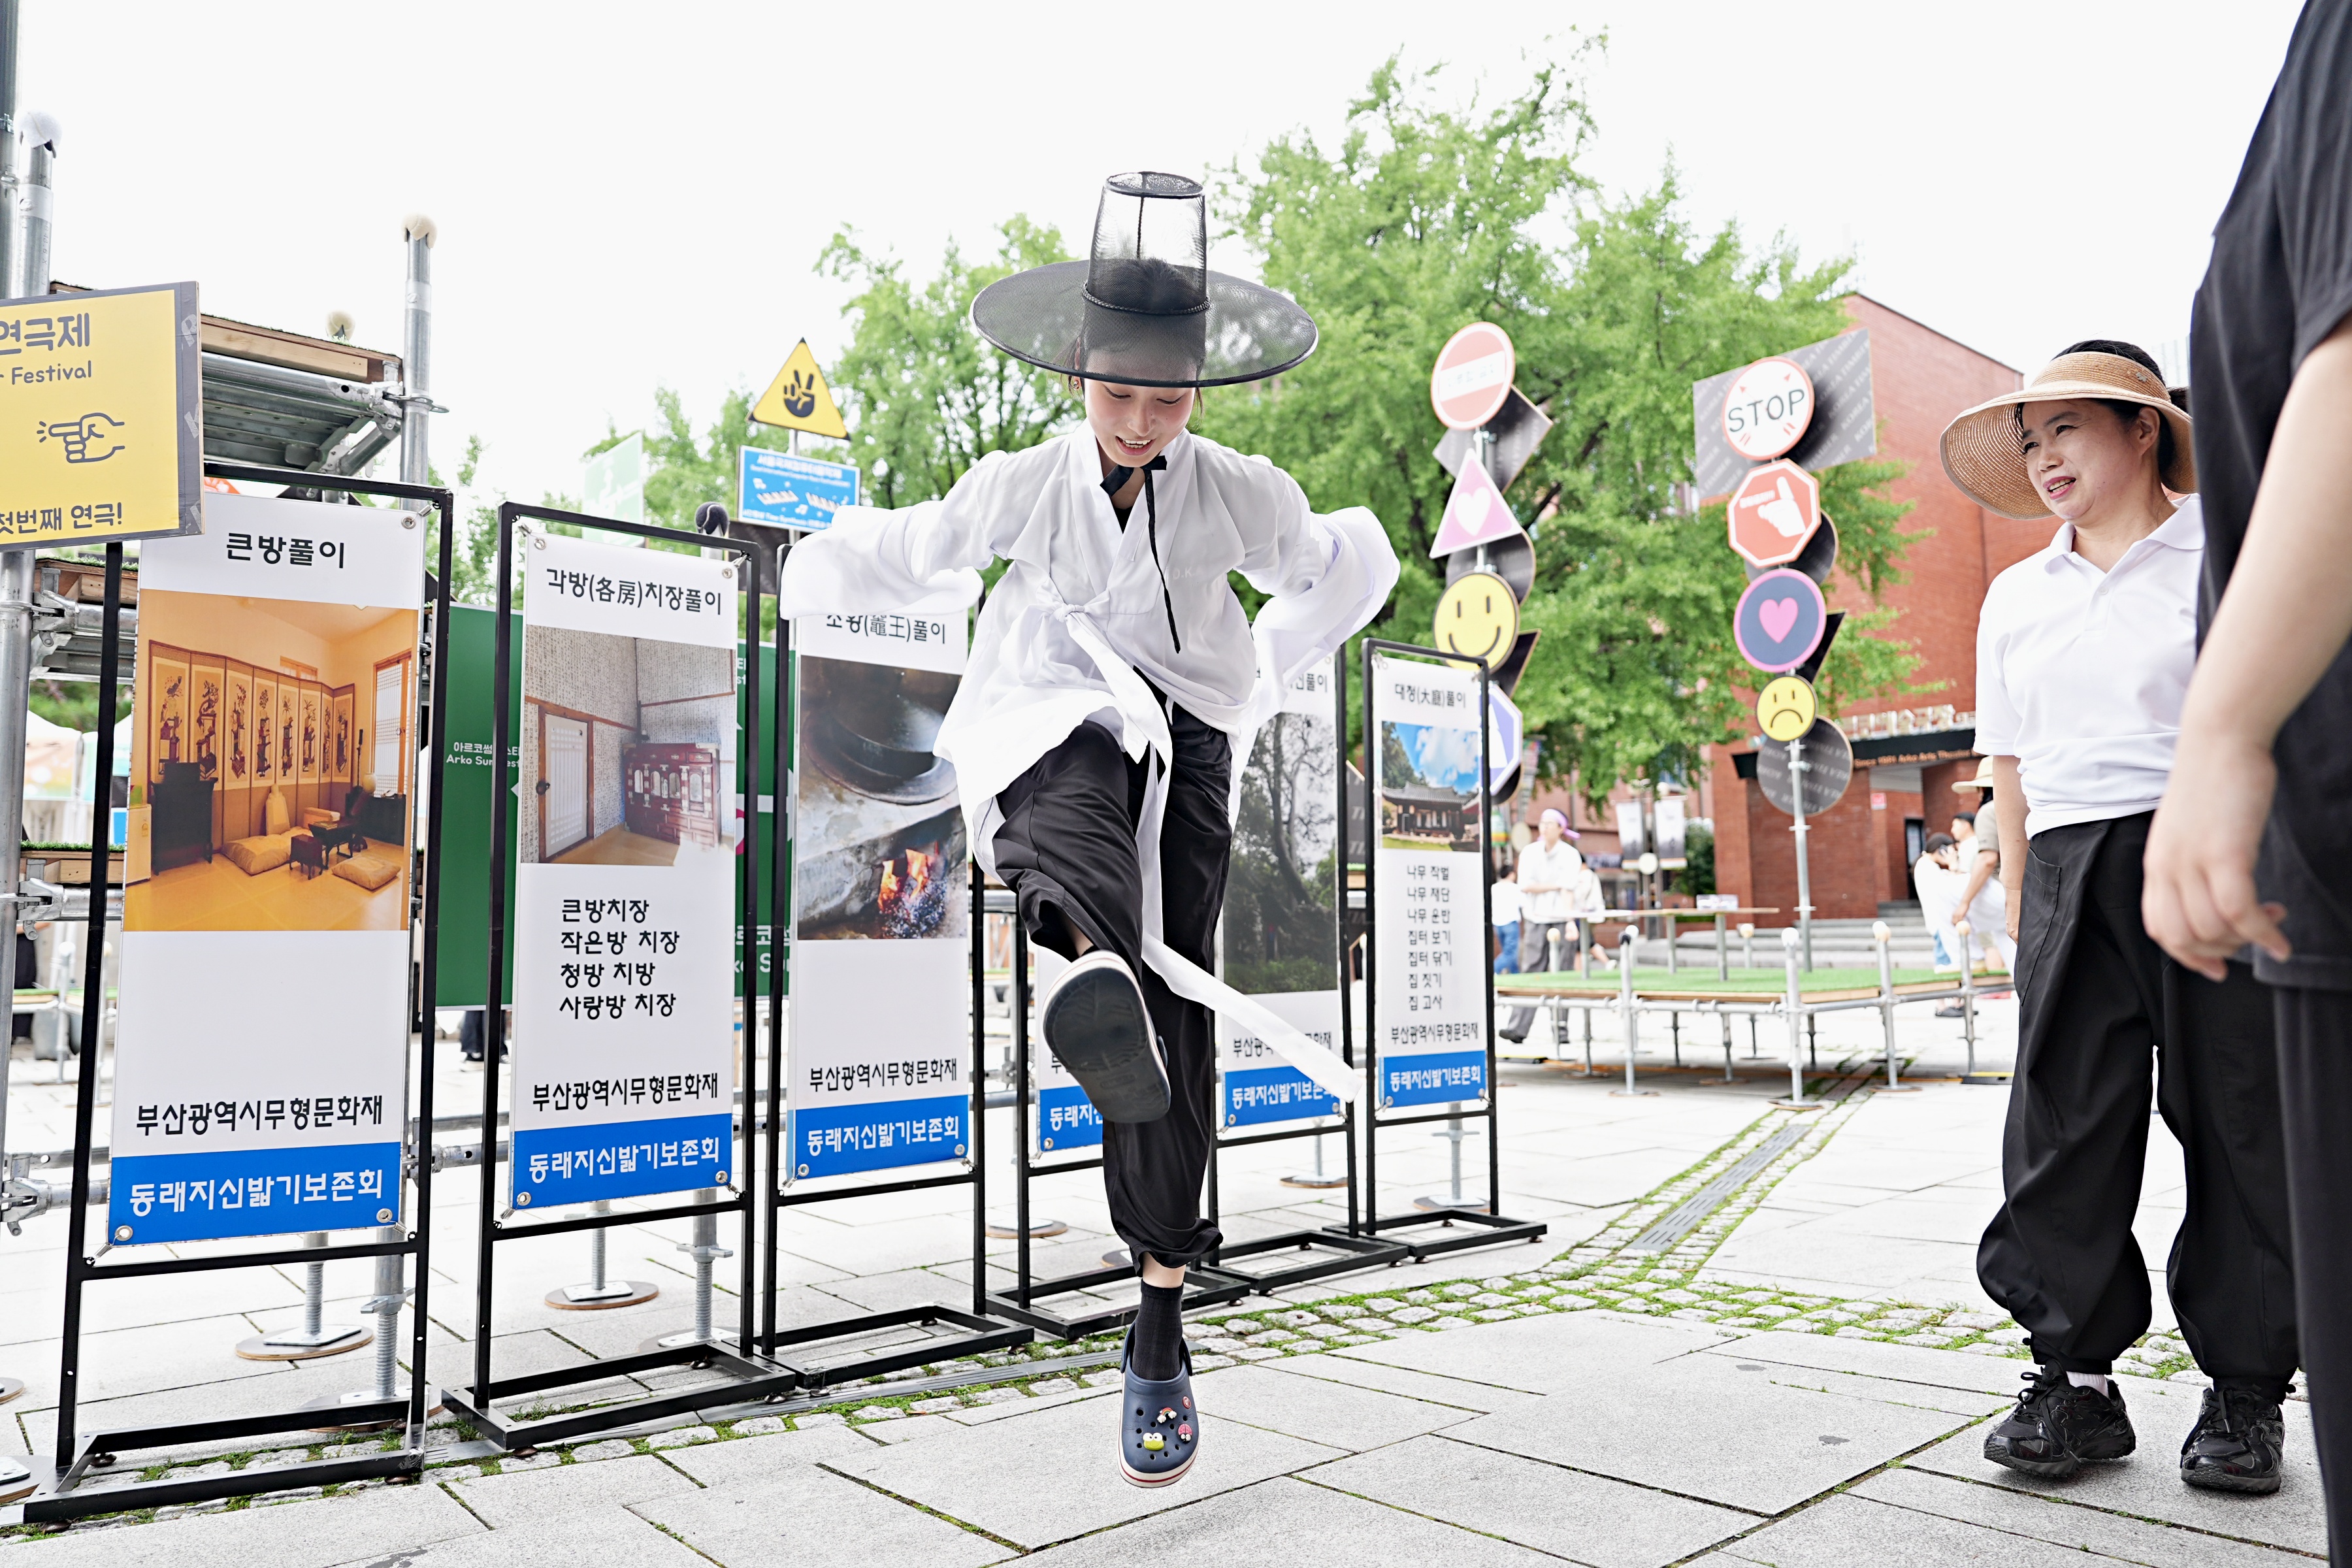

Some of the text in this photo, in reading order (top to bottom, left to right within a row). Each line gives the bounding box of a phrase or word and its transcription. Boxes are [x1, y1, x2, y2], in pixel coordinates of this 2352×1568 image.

[11, 360, 92, 385] Festival
[1728, 389, 1805, 433] STOP
[71, 502, 122, 529] 연극!
[226, 532, 344, 569] 큰방풀이
[546, 568, 721, 615] 각방(各房)치장풀이
[446, 754, 472, 764] Arko
[1407, 865, 1426, 879] 나무
[1407, 887, 1426, 902] 나무
[562, 898, 649, 924] 큰방치장
[1408, 908, 1450, 924] 나무 운반
[561, 930, 680, 955] 작은방 치장
[1409, 930, 1450, 945] 집터 보기
[1409, 952, 1428, 967] 집터
[560, 962, 656, 988] 청방 치방
[1409, 973, 1441, 989] 집 짓기
[559, 993, 677, 1021] 사랑방 치장
[1409, 995, 1443, 1011] 집 고사
[1391, 1022, 1478, 1045] 부산광역시무형문화재
[809, 1058, 956, 1092] 부산광역시무형문화재
[532, 1072, 718, 1111] 부산광역시무형문화재
[136, 1095, 382, 1136] 부산광역시무형문화재
[807, 1115, 960, 1156] 동래지신밟기보존회
[529, 1137, 719, 1183] 동래지신밟기보존회
[129, 1169, 383, 1217] 동래지신밟기보존회
